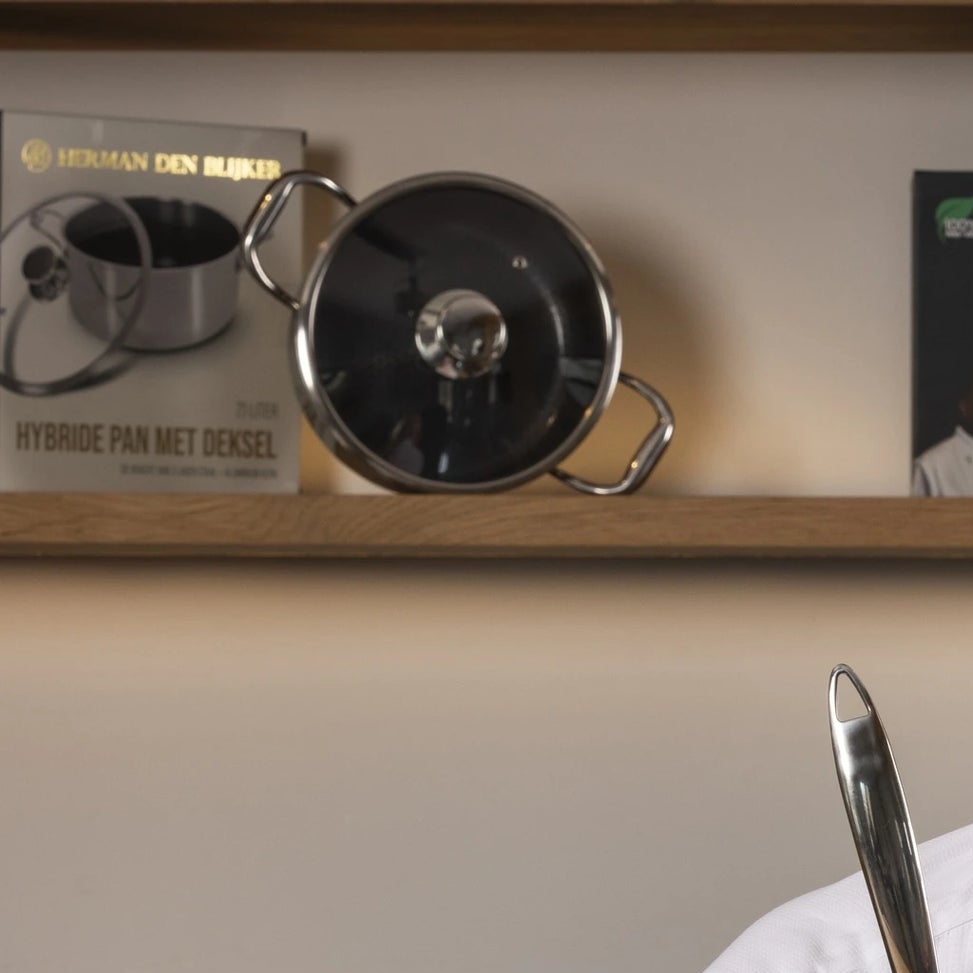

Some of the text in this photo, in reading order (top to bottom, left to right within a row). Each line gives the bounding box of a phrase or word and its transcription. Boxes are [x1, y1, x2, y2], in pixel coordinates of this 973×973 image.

[57, 147, 148, 171] HERMAN
[154, 152, 198, 175] DEN
[203, 156, 281, 181] BLIJKER
[16, 421, 279, 459] HYBRIDE PAN MET DEKSEL
